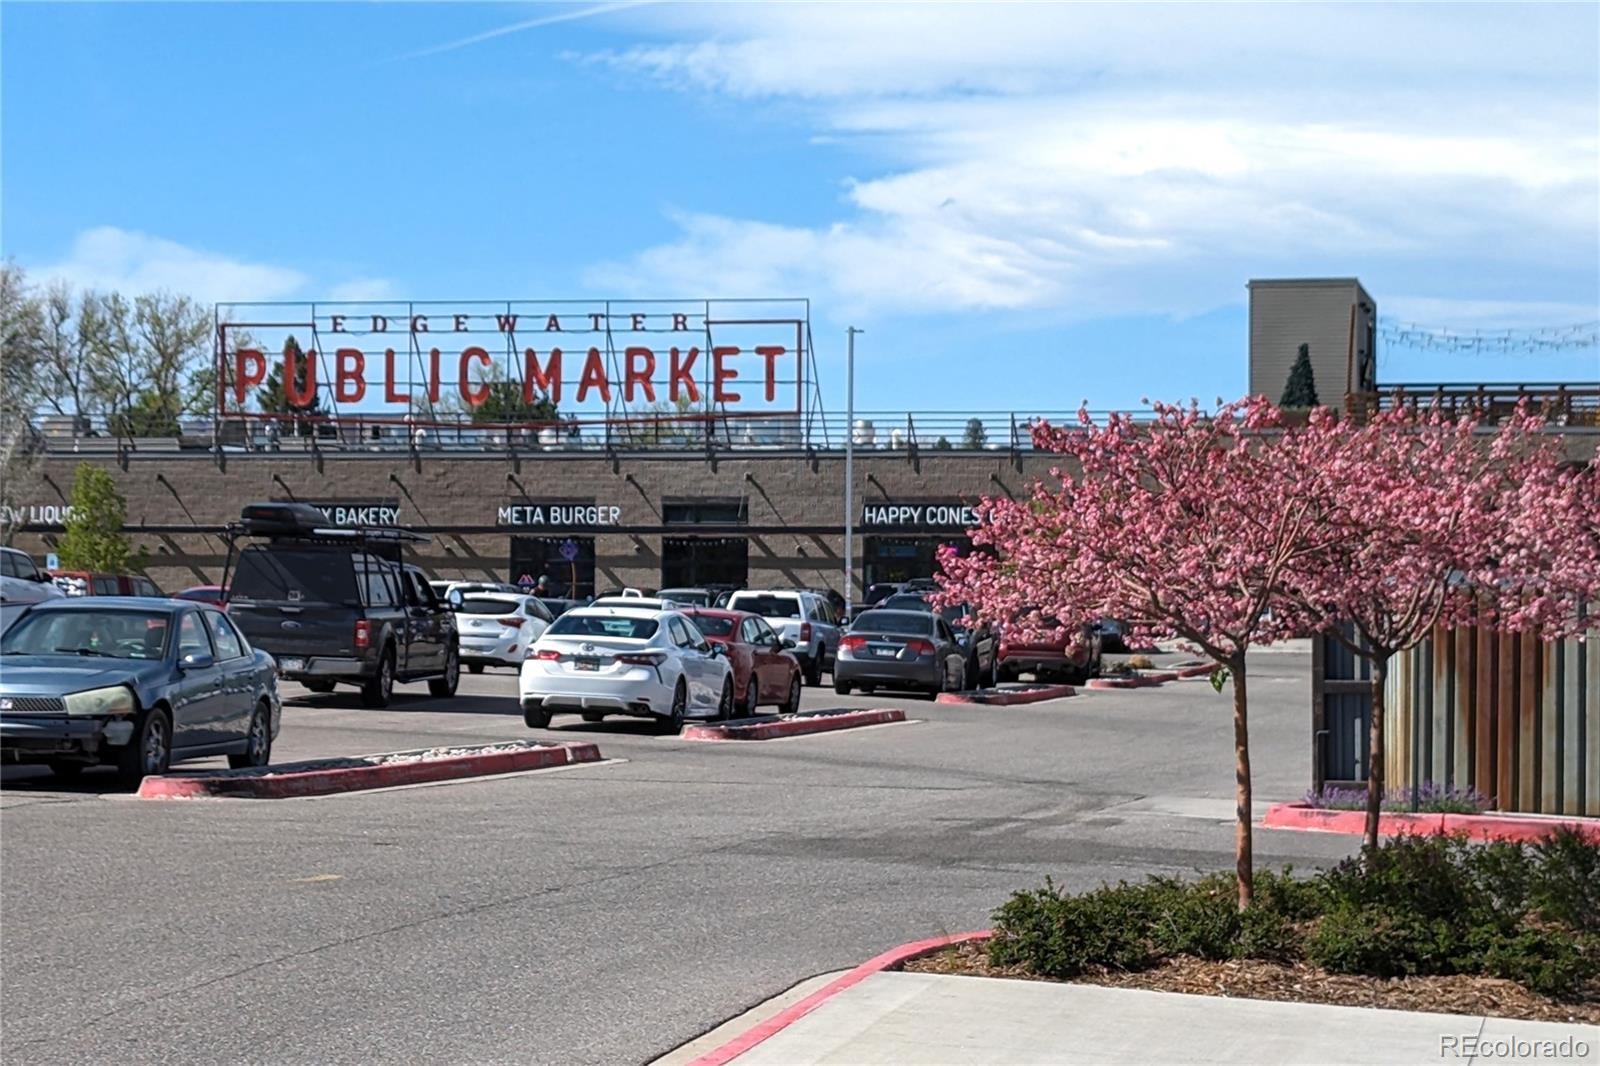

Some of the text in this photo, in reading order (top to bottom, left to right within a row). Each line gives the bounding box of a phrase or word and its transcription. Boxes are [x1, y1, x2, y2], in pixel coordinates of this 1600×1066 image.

[331, 313, 689, 333] EDGEWATER
[236, 346, 787, 407] PUBLIC MARKET
[335, 506, 401, 525] BAKERY
[498, 506, 622, 525] META BURGER
[864, 506, 922, 525] HAPPY
[926, 506, 981, 525] CONES
